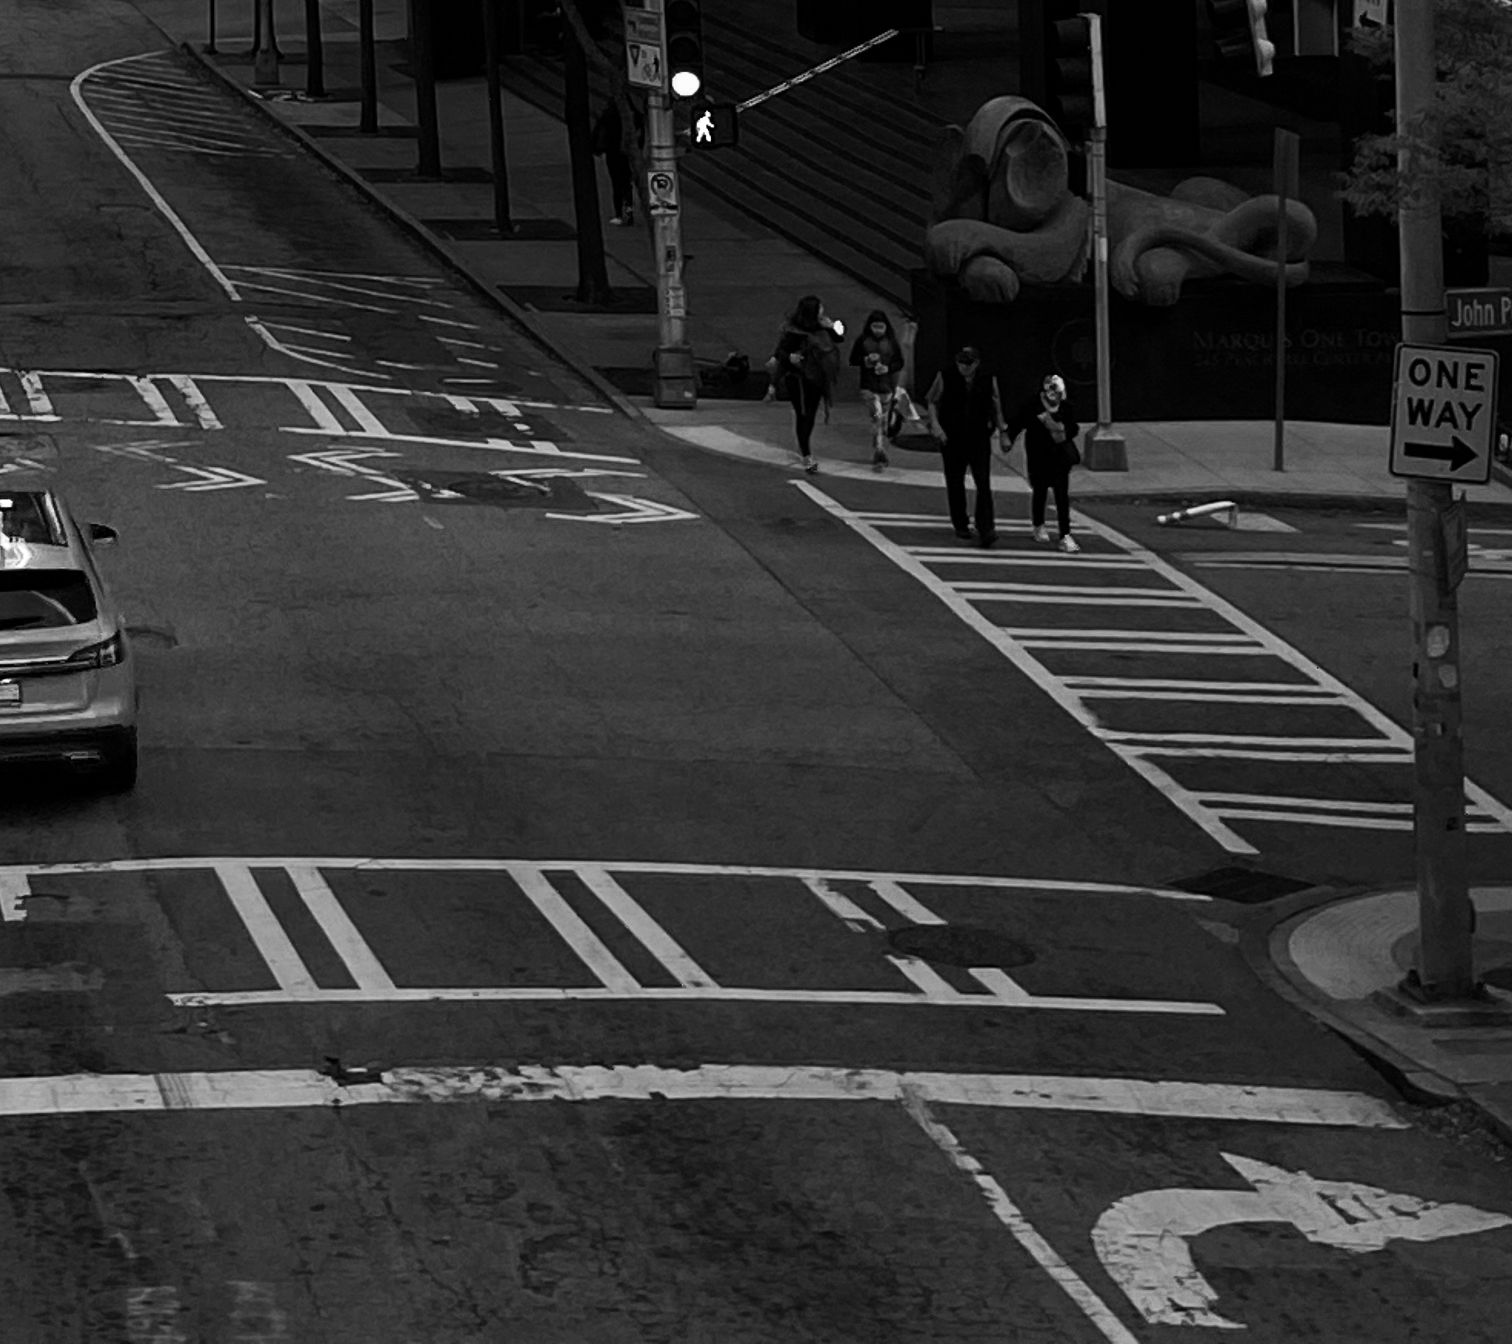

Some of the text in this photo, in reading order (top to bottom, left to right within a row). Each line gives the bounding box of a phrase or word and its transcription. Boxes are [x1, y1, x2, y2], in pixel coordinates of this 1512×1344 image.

[1451, 296, 1495, 328] John
[1193, 330, 1293, 350] MARQUS
[1408, 358, 1485, 392] ONE
[1407, 396, 1483, 431] WAY
